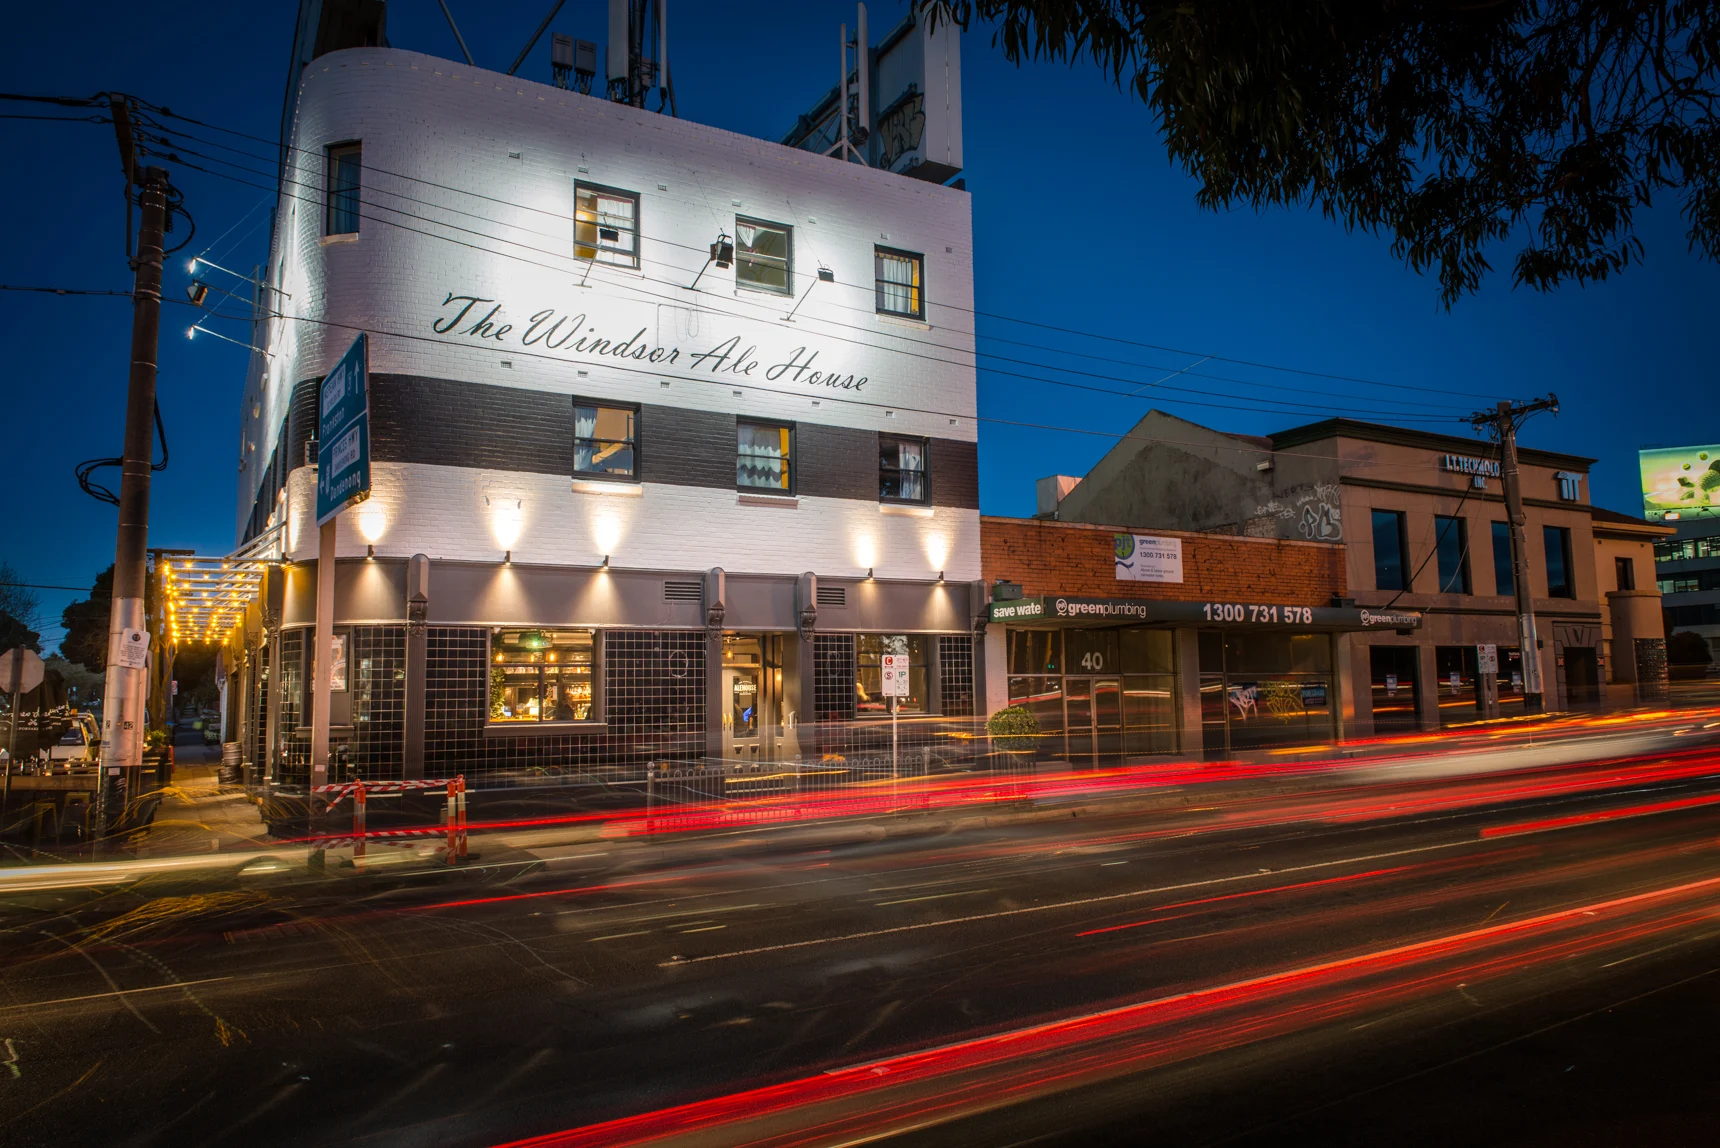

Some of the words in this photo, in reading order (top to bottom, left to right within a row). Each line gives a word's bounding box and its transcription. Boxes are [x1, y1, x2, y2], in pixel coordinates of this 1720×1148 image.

[433, 292, 514, 342] The
[522, 308, 680, 364] Windsor
[690, 335, 758, 376] Ale
[766, 345, 868, 391] House
[322, 407, 345, 440] Frankston
[330, 470, 361, 502] Dandenong
[1139, 551, 1154, 559] 1300
[993, 605, 1017, 618] save
[1017, 602, 1042, 616] wate
[1068, 602, 1147, 618] greenplumbing
[1203, 603, 1244, 622] 1300
[1249, 605, 1278, 623] 731
[1284, 607, 1313, 624] 578
[1369, 613, 1418, 626] greenplumbing
[1081, 652, 1103, 670] 40
